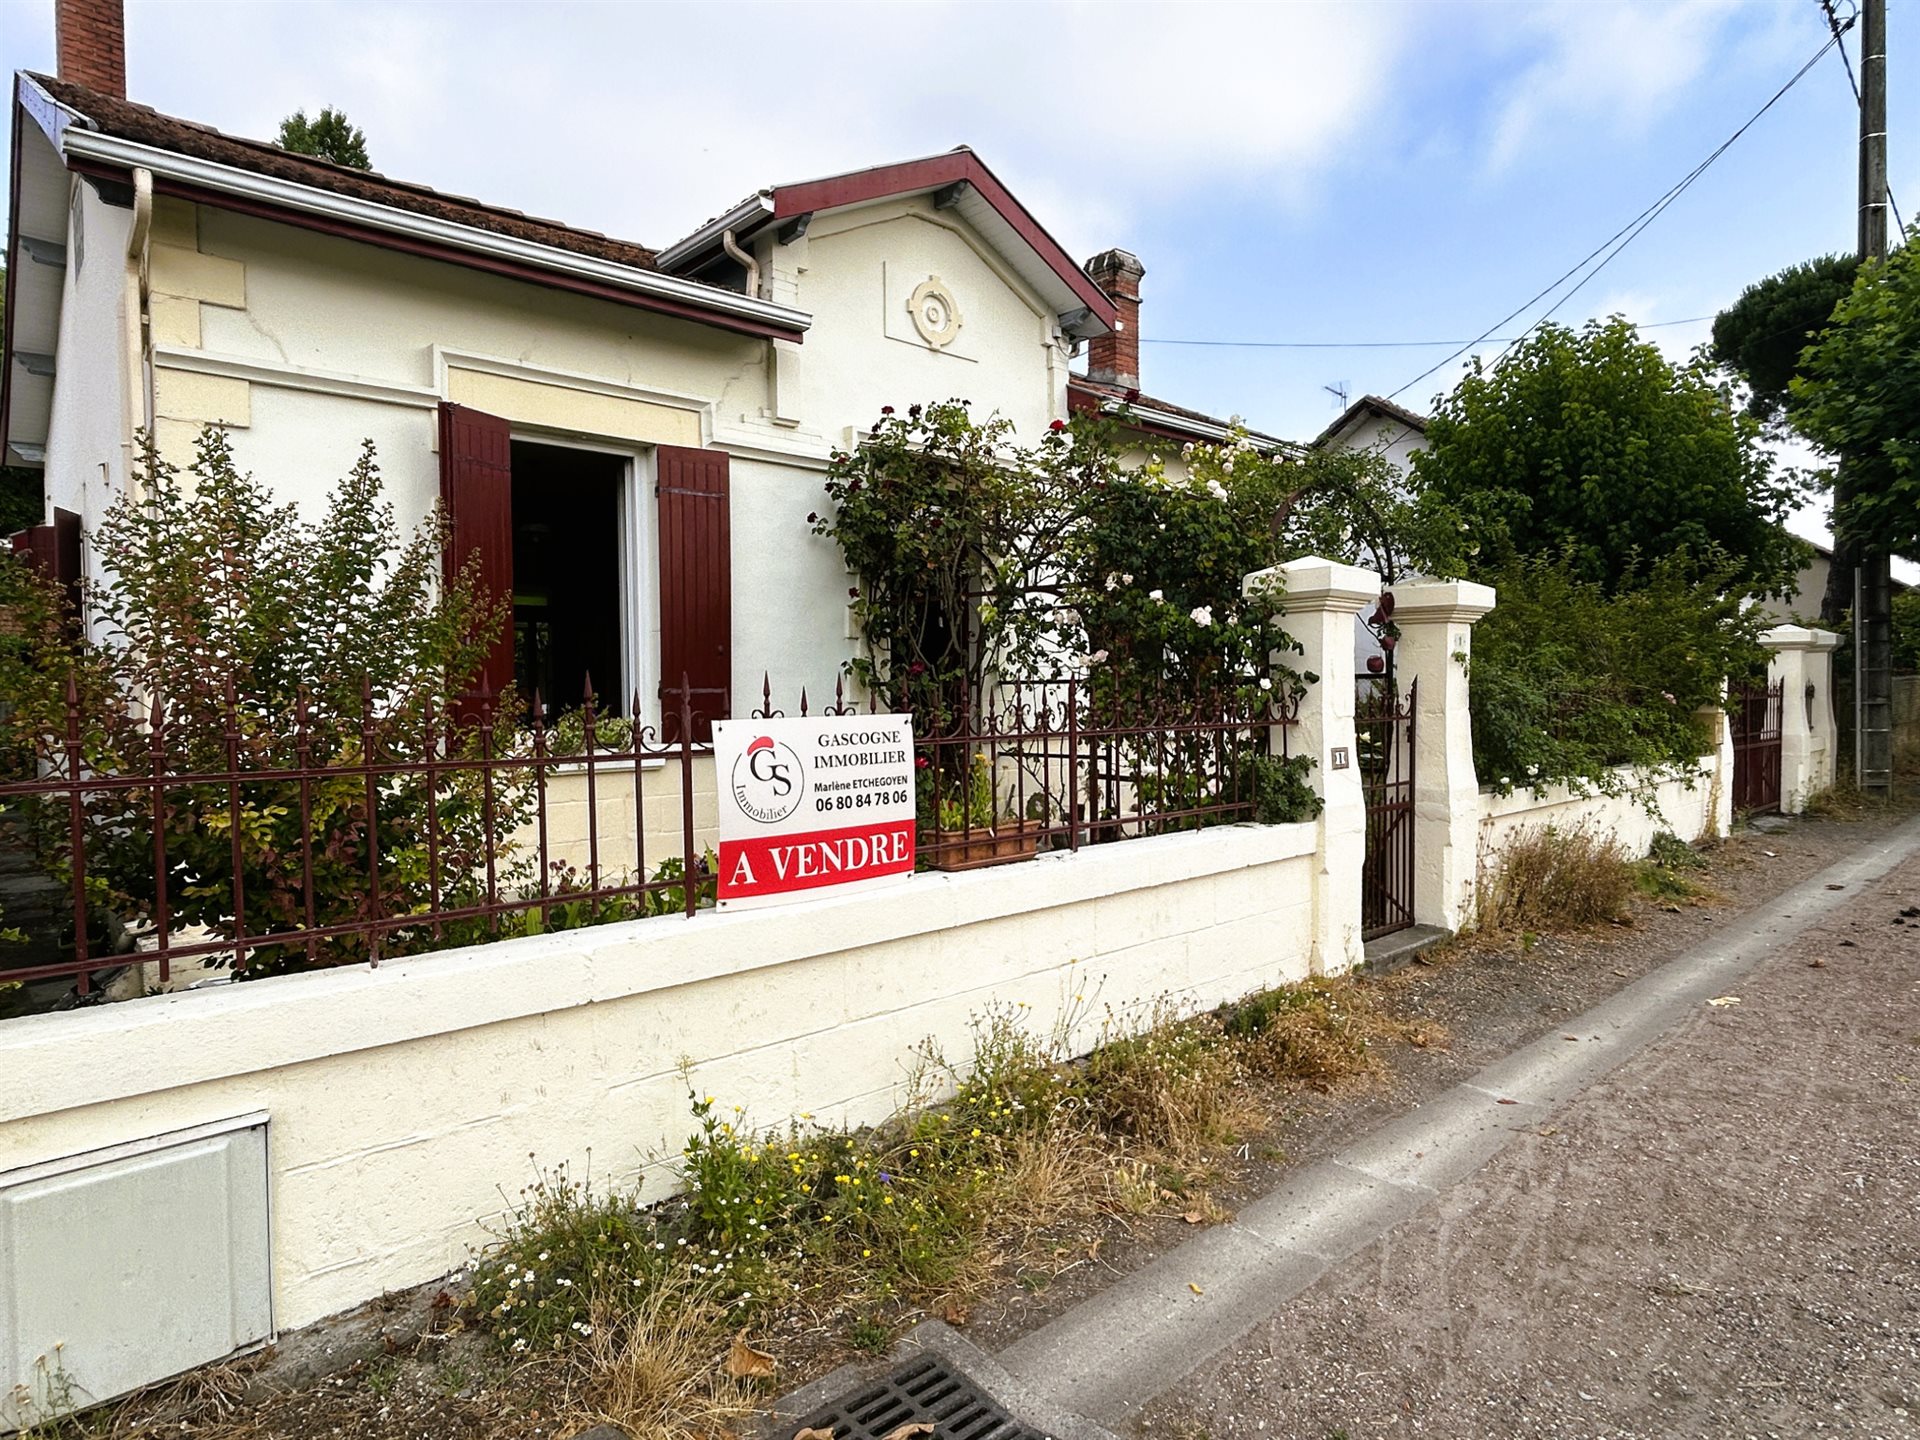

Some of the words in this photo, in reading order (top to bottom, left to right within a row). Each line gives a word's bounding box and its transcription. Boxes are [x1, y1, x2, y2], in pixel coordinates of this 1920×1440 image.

[818, 731, 901, 747] GASCOGNE
[814, 750, 906, 768] IMMOBILIER
[814, 781, 851, 792] Marlène
[853, 775, 908, 789] ETCHEGOYEN
[736, 784, 787, 820] Immobilier
[816, 798, 832, 812] 06
[836, 796, 853, 809] 80
[856, 794, 871, 807] 84
[875, 792, 889, 805] 78
[893, 790, 907, 803] 06
[728, 851, 758, 886] A
[769, 831, 909, 880] VENDRE
